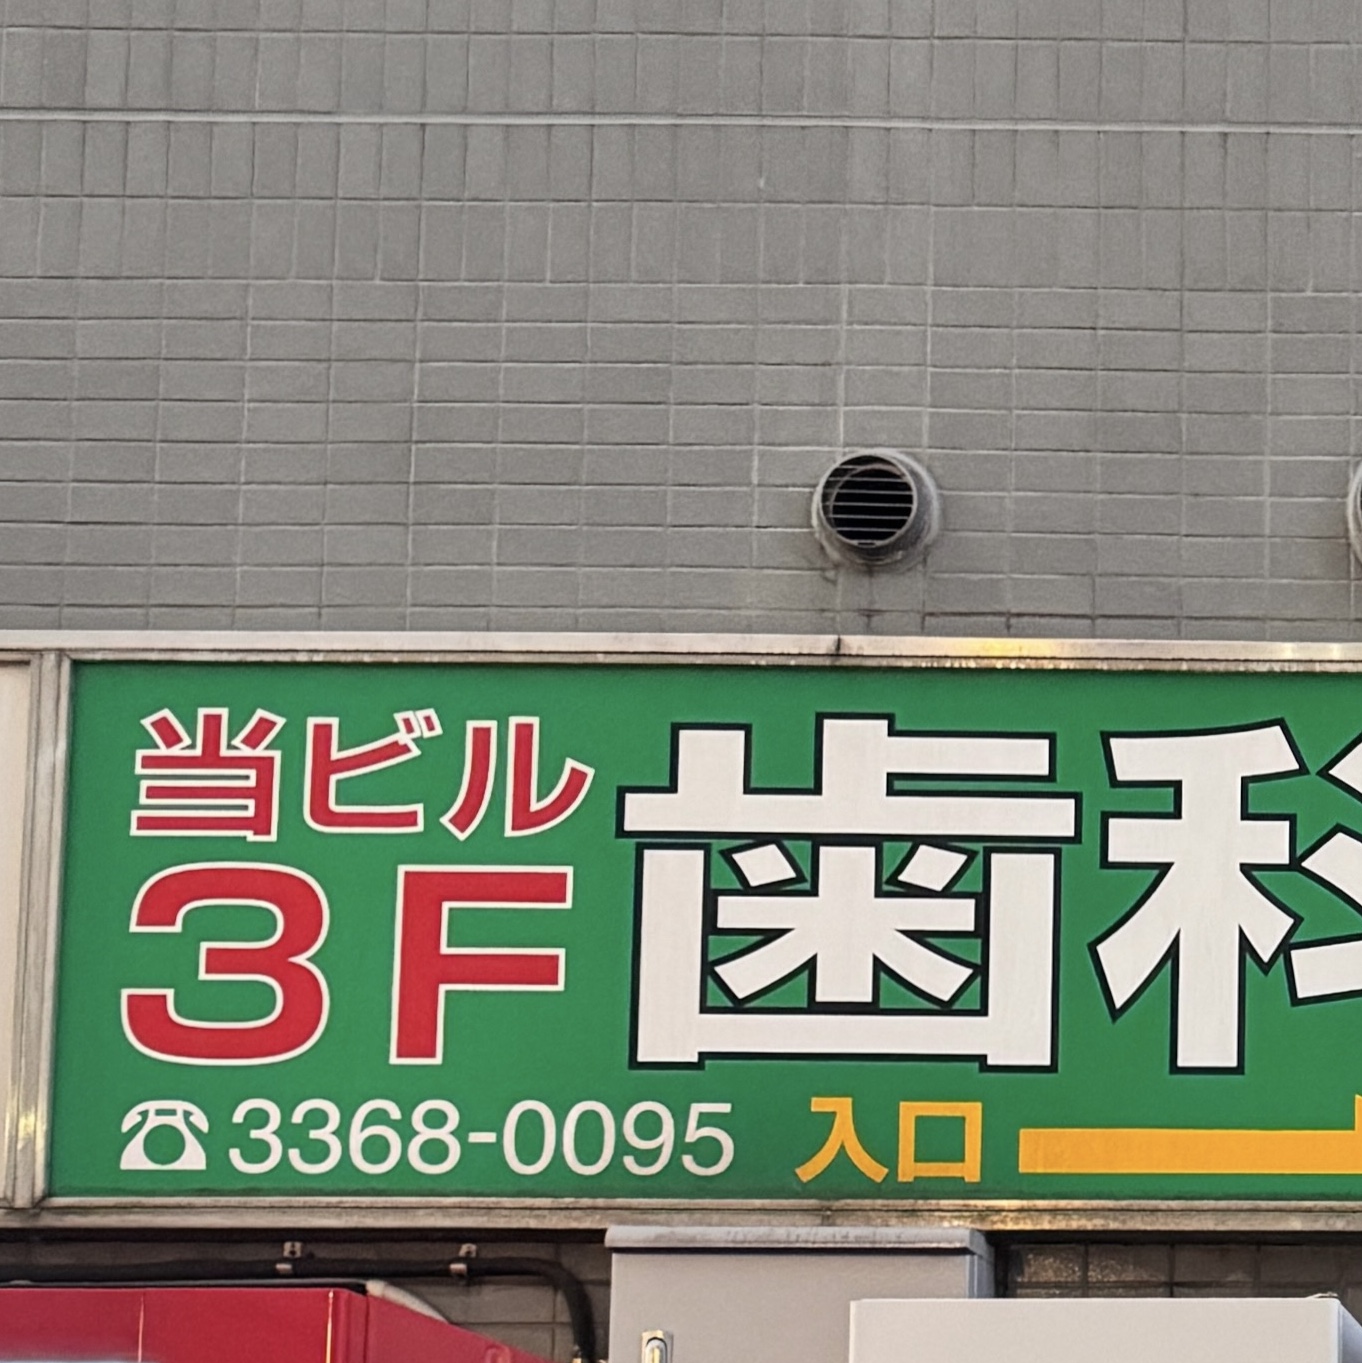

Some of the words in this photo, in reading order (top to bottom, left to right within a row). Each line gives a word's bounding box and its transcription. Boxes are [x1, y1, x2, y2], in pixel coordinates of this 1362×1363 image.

[129, 707, 596, 842] 当ビル
[121, 864, 574, 1066] 3F
[228, 1097, 737, 1177] 3368-0095
[794, 1096, 983, 1185] 入口
